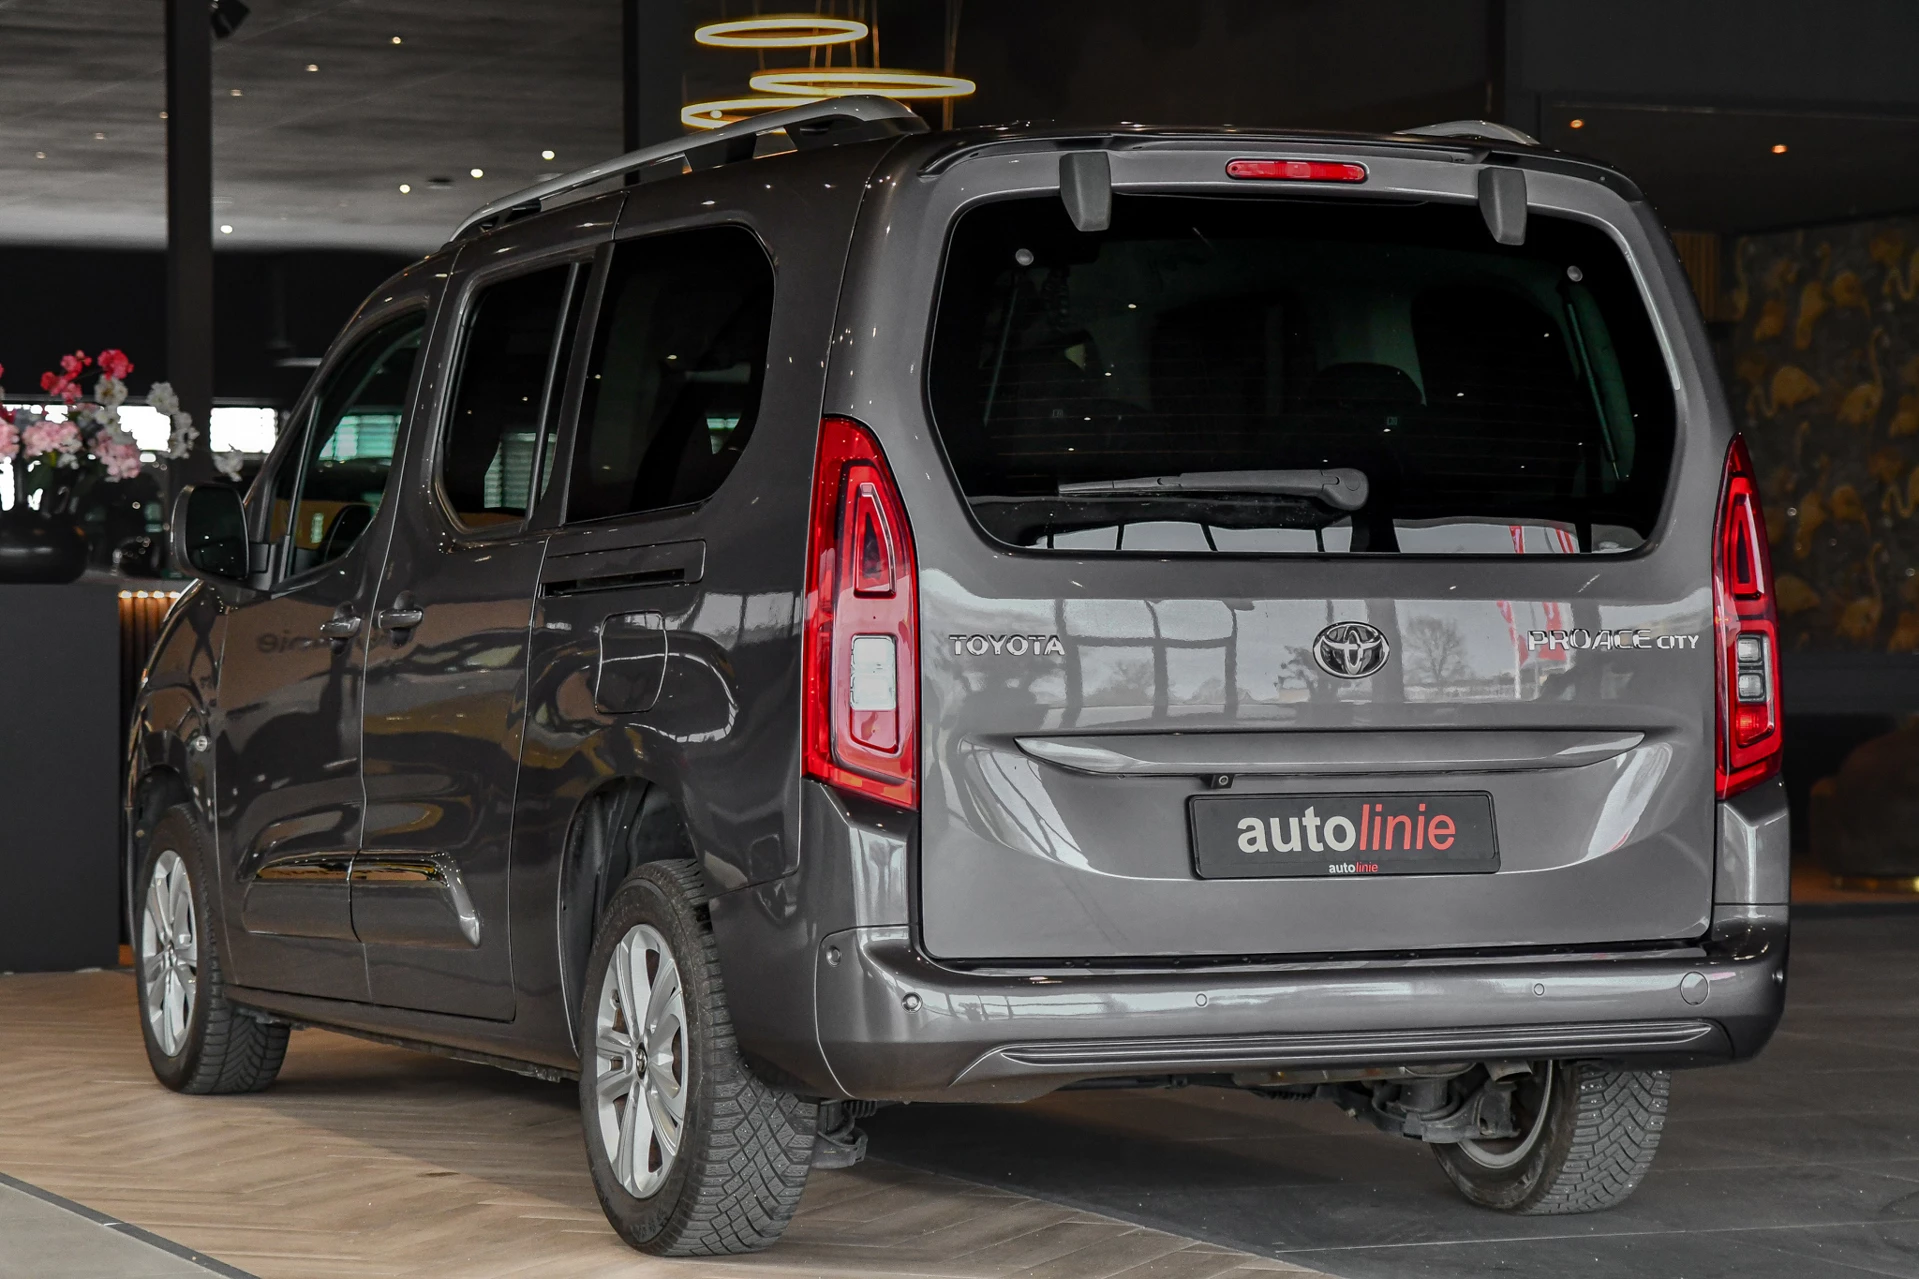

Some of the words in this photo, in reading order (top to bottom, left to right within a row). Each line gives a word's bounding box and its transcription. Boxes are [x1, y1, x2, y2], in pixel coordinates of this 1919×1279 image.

[949, 634, 1065, 657] TOYOTA
[1527, 628, 1653, 651] PROACE
[1656, 634, 1700, 650] CITY
[1237, 803, 1456, 853] autolinie
[1328, 862, 1379, 874] autolinie
